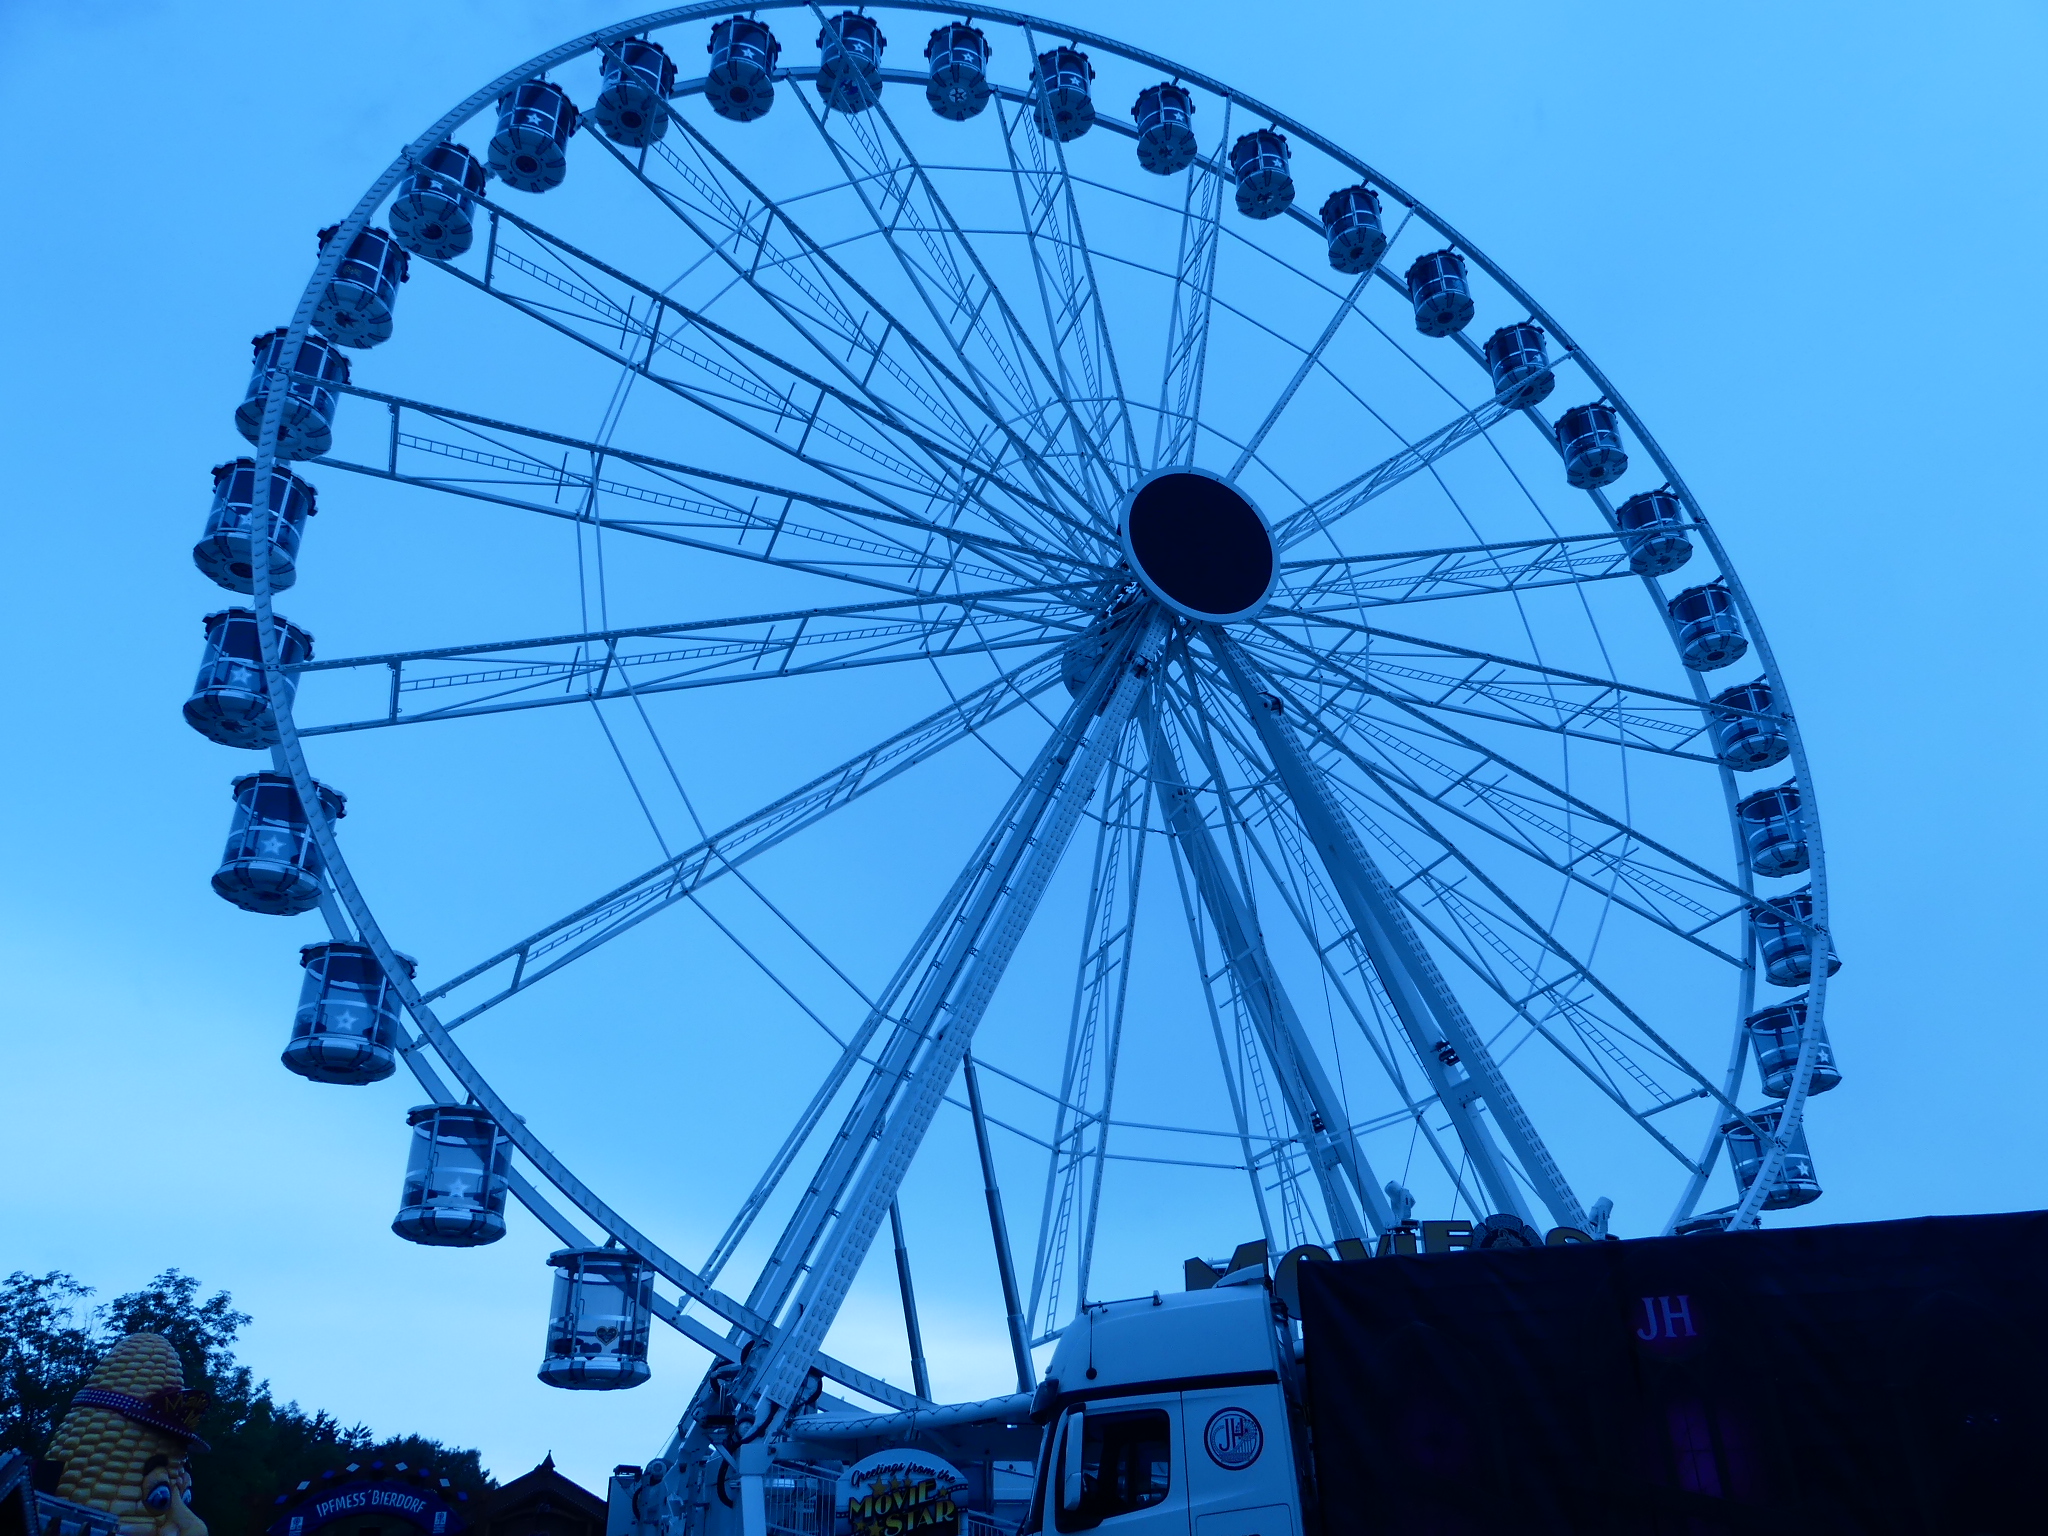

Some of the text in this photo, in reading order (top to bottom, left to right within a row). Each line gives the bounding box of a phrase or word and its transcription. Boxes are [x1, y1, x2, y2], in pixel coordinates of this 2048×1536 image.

[1637, 1294, 1697, 1341] JH
[851, 1461, 956, 1488] Greetings from the
[849, 1479, 936, 1521] MOVIE
[884, 1500, 956, 1536] STAR
